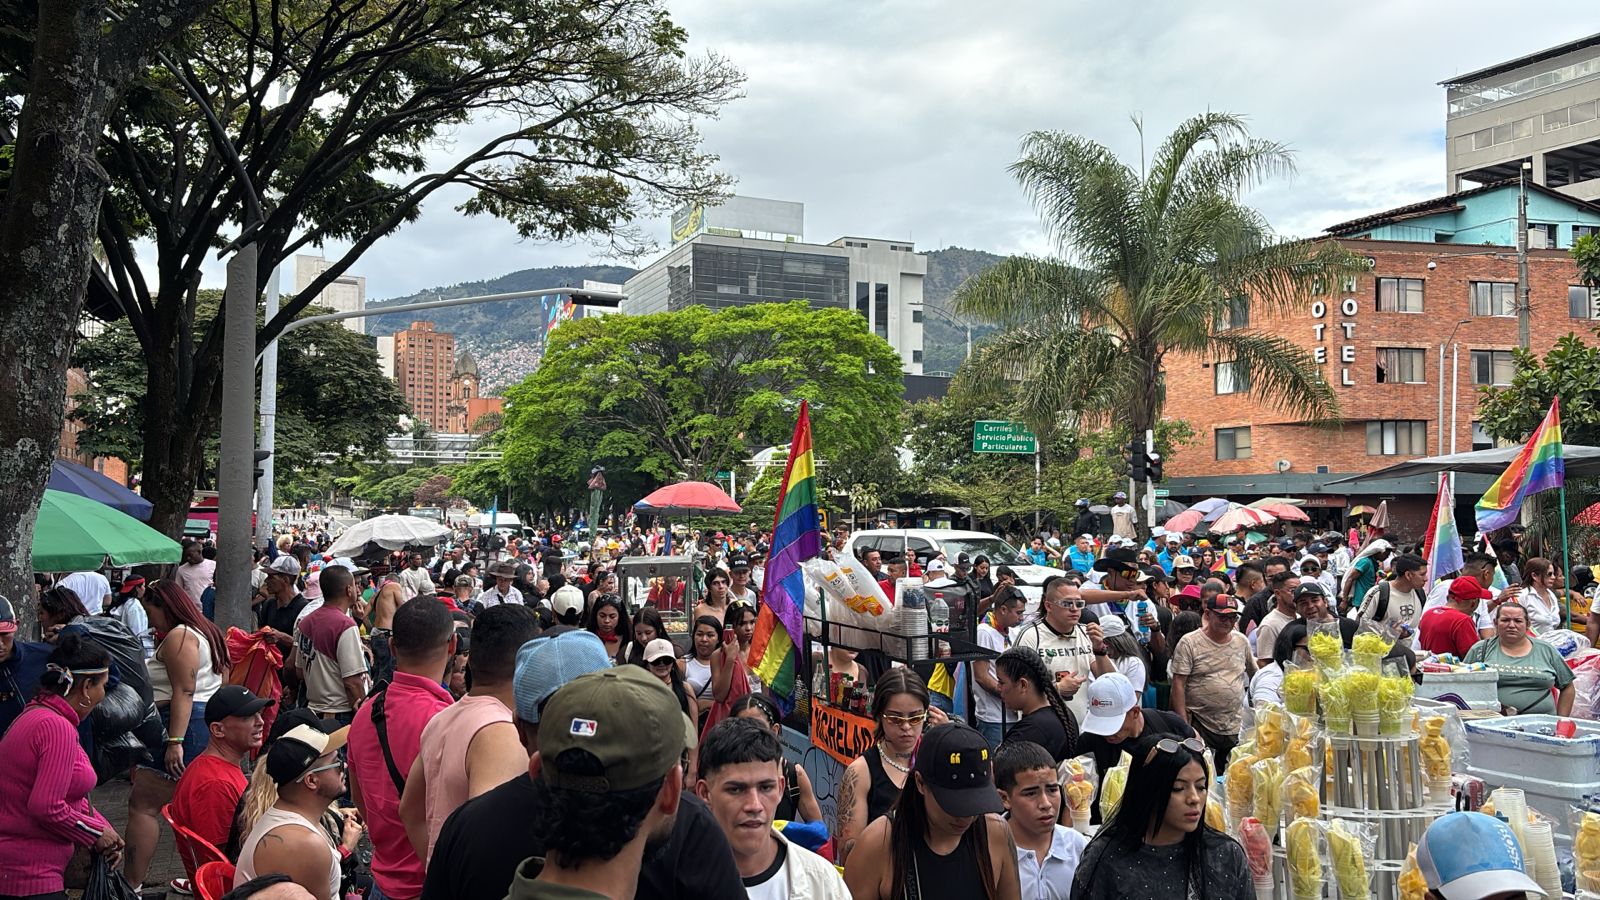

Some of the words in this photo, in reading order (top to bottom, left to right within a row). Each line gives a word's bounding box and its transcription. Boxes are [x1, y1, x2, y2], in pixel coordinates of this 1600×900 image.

[1341, 275, 1358, 385] HOTEL
[983, 424, 1012, 433] Carriles
[976, 433, 1006, 441] Servicio
[982, 442, 1027, 451] Particulares
